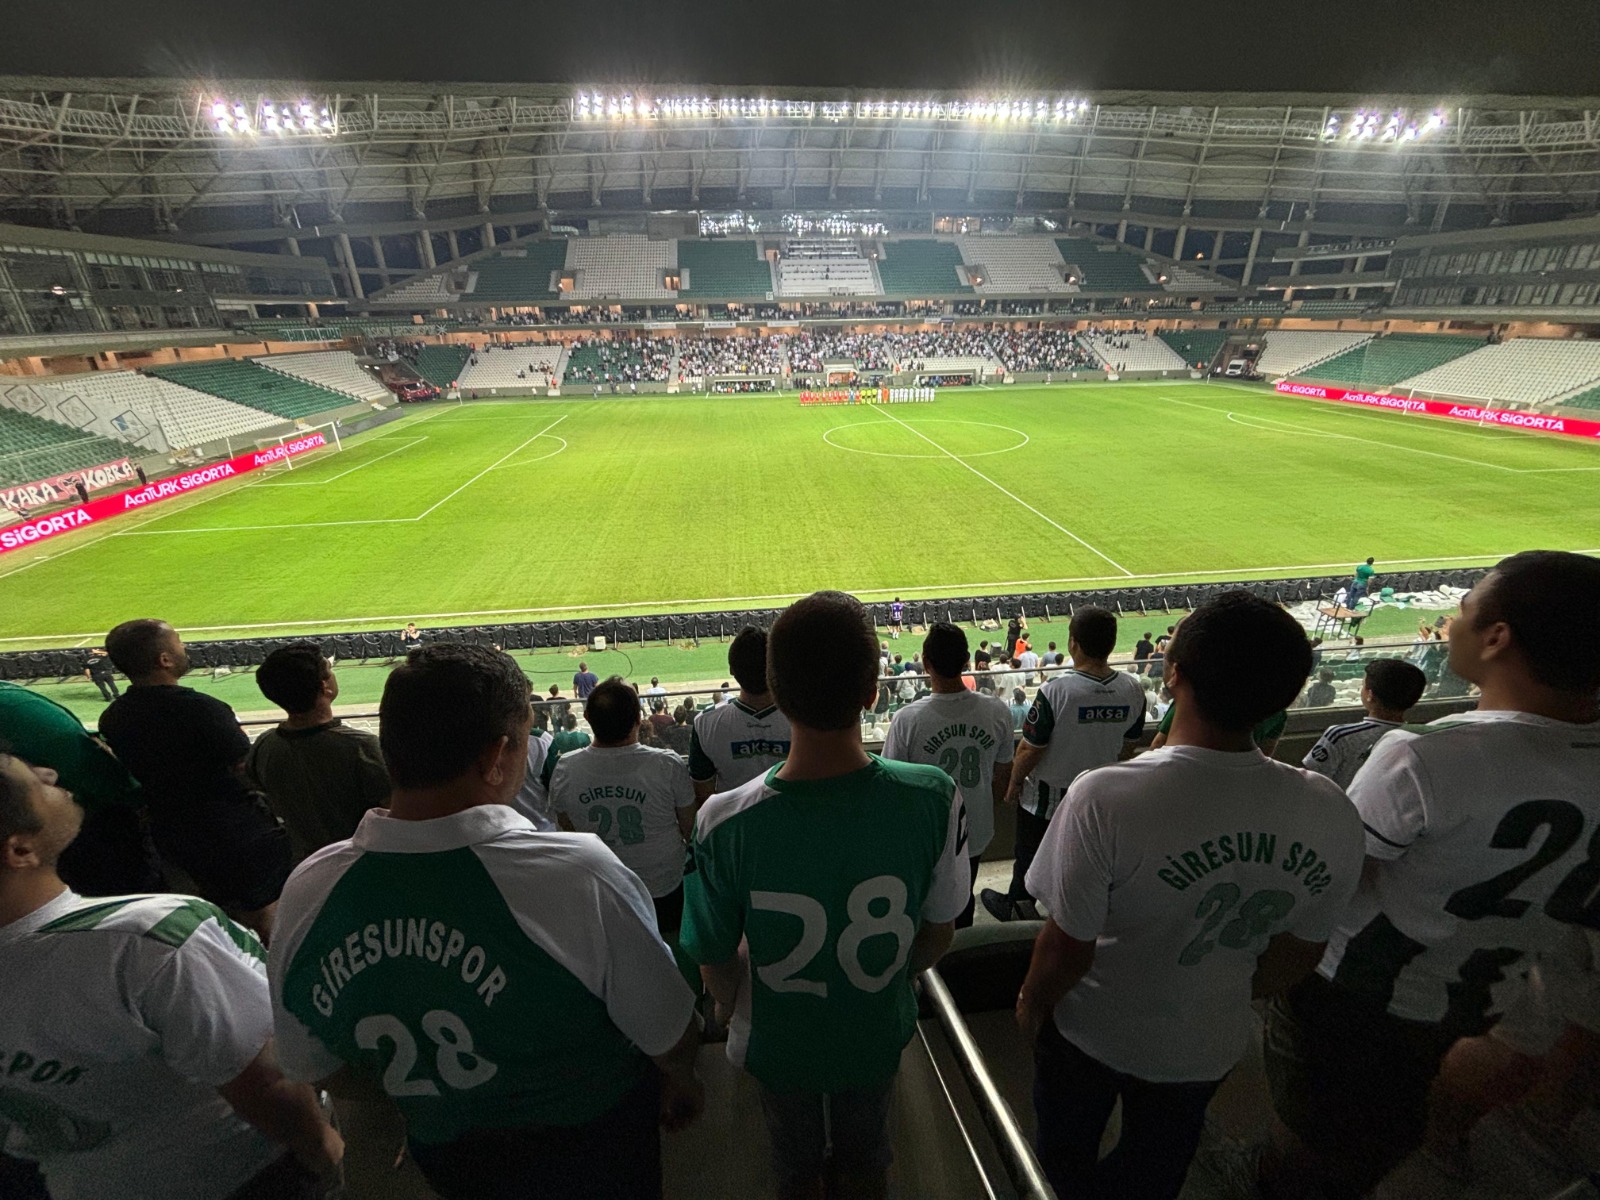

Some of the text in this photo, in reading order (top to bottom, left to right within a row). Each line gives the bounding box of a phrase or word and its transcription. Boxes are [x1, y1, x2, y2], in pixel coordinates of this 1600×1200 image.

[0, 460, 134, 509] KARA KOBRA
[939, 745, 981, 788] 28
[588, 804, 646, 846] 28
[750, 875, 915, 999] 28
[1178, 882, 1296, 967] 28
[354, 1009, 499, 1097] 28
